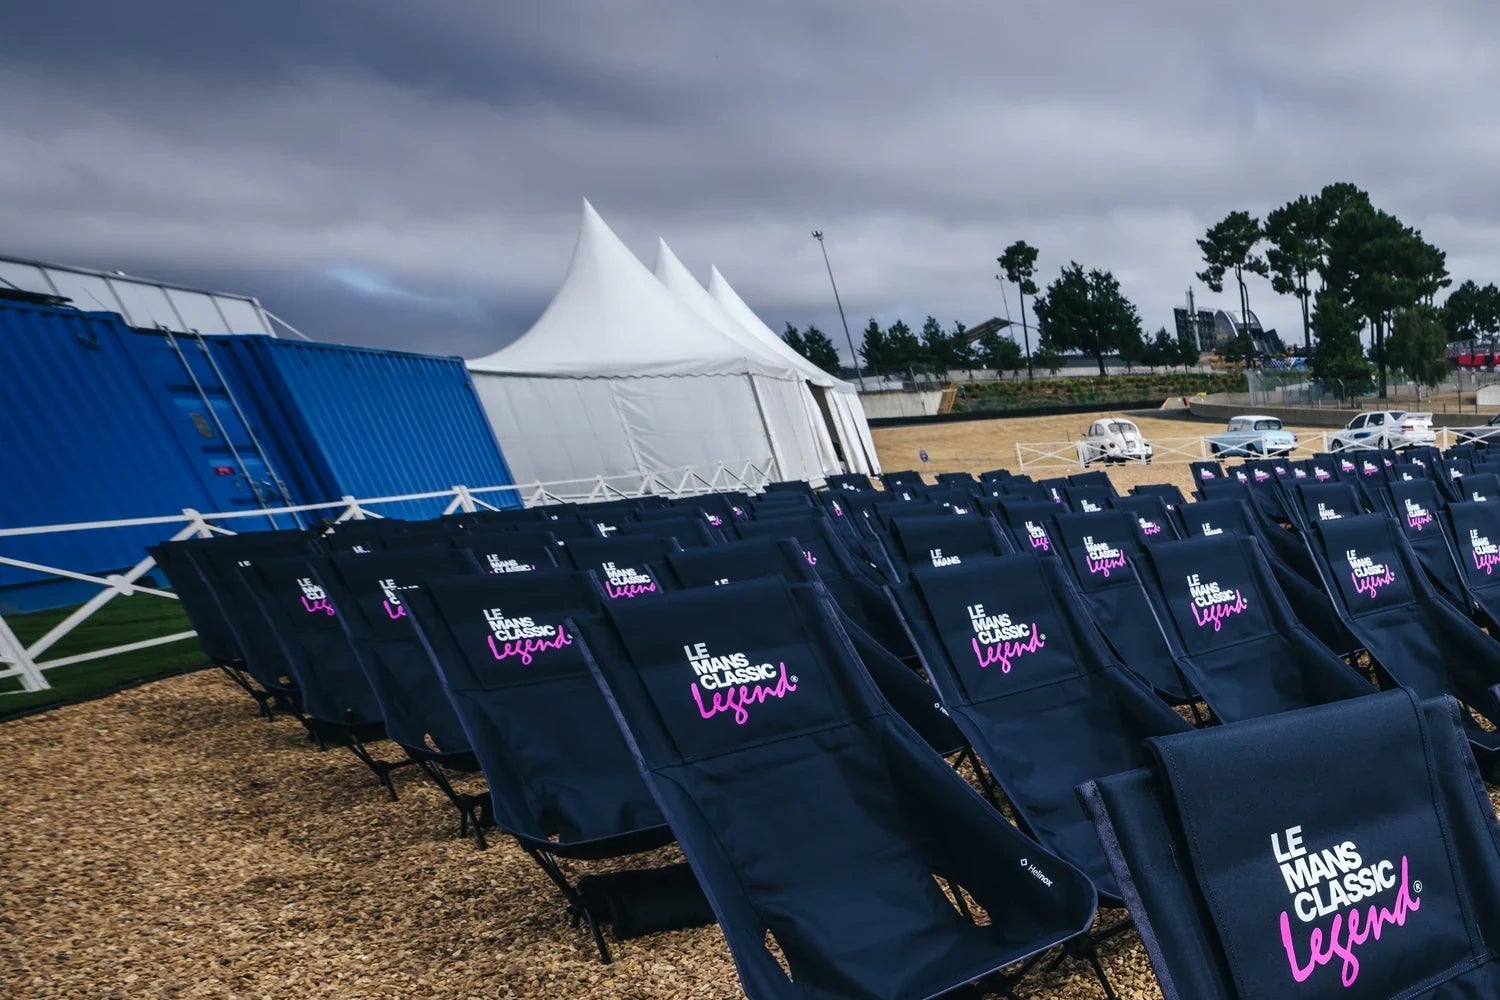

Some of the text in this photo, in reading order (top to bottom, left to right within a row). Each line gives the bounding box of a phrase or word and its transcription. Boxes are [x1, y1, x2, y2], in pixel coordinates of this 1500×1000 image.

[1083, 536, 1094, 545] LE
[1470, 529, 1478, 538] LE
[930, 548, 942, 559] LE
[1086, 542, 1110, 552] MANS
[486, 554, 500, 562] LE
[1090, 549, 1120, 560] CLASSIC
[1346, 550, 1357, 560] LE
[490, 560, 518, 568] MANS
[602, 562, 617, 571] LE
[932, 556, 962, 568] MANS
[1350, 556, 1373, 570] MANS
[606, 568, 637, 578] MANS
[1354, 564, 1385, 578] CLASSIC
[296, 578, 313, 587] LE
[379, 579, 397, 590] LE
[610, 574, 652, 586] CLASSIC
[1187, 574, 1201, 588] LE
[1190, 582, 1220, 598] MANS
[1194, 590, 1236, 607] CLASSIC
[483, 608, 505, 622] LE
[967, 604, 986, 620] LE
[488, 616, 535, 632] MANS
[972, 613, 1012, 633] MANS
[494, 624, 556, 642] CLASSIC
[977, 624, 1030, 645] CLASSIC
[684, 642, 711, 662] LE
[690, 652, 750, 676] MANS
[700, 663, 777, 690] CLASSIC
[1270, 824, 1308, 864] LE
[1280, 840, 1363, 894] MANS
[1028, 864, 1054, 888] Helinox
[1294, 860, 1396, 923] CLASSIC
